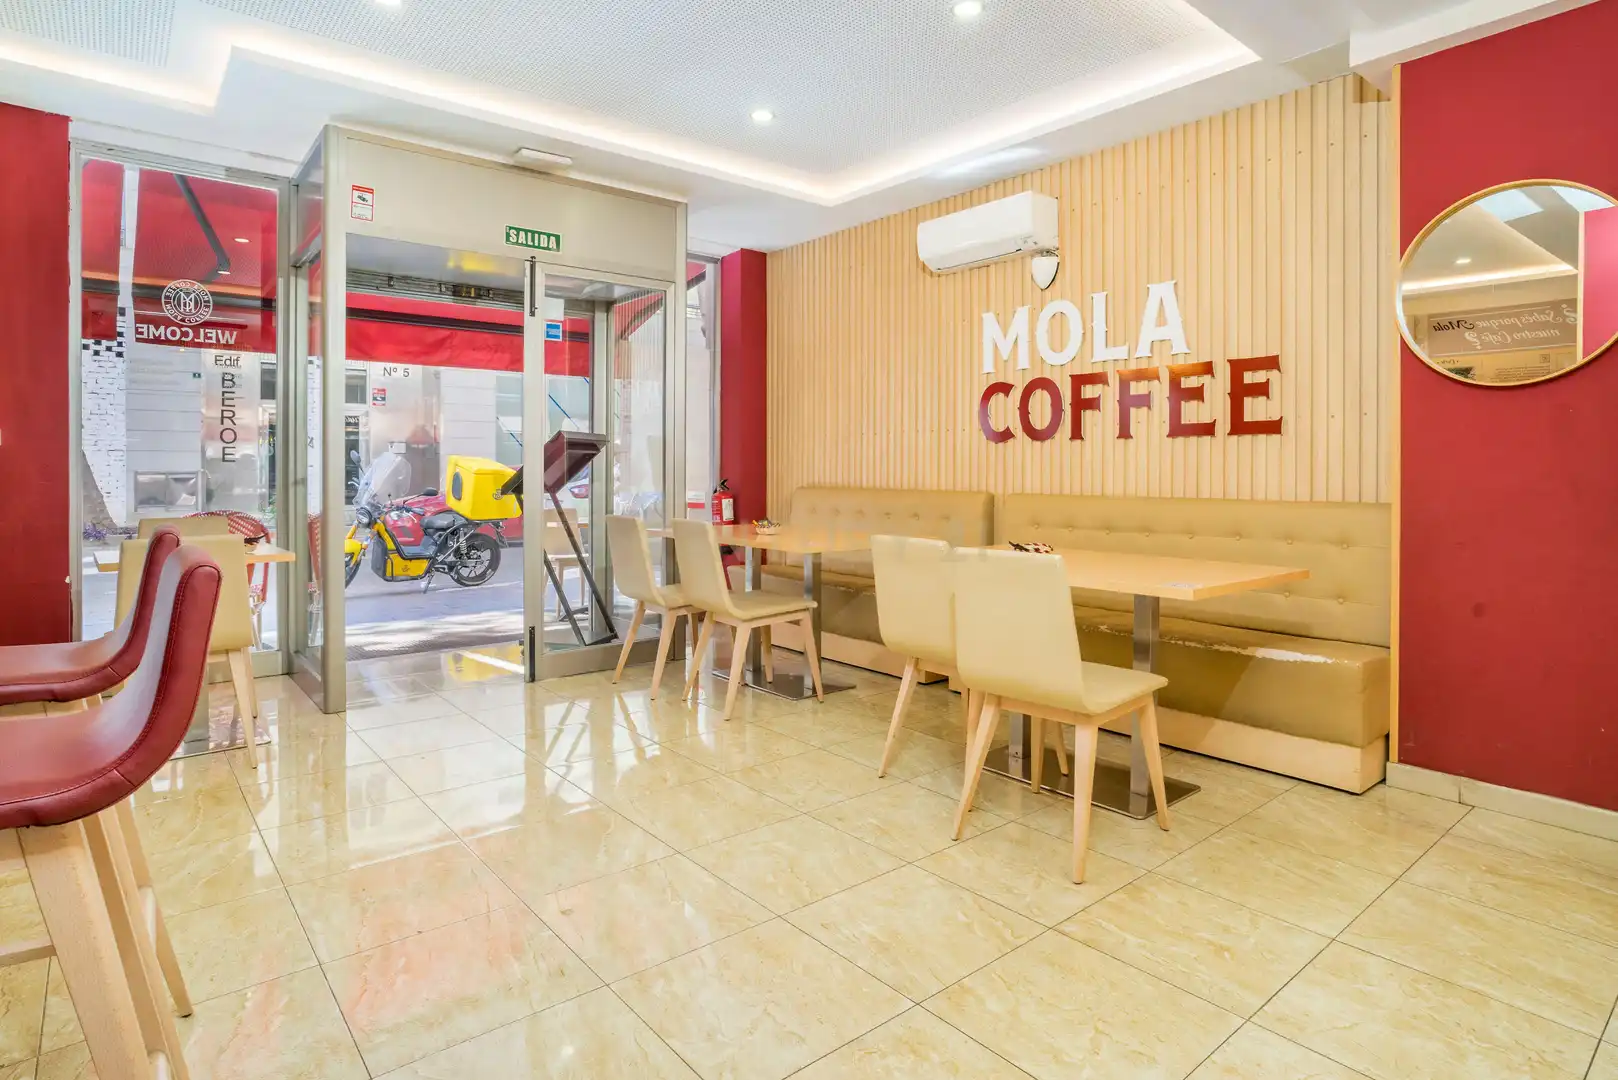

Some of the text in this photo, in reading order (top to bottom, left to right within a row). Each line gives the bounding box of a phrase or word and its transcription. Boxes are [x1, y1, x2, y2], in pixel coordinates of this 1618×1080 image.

[509, 229, 557, 249] SALIDA
[981, 280, 1191, 373] MOLA
[220, 371, 238, 463] BEROE
[402, 367, 410, 378] 5
[978, 354, 1284, 444] COFFEE
